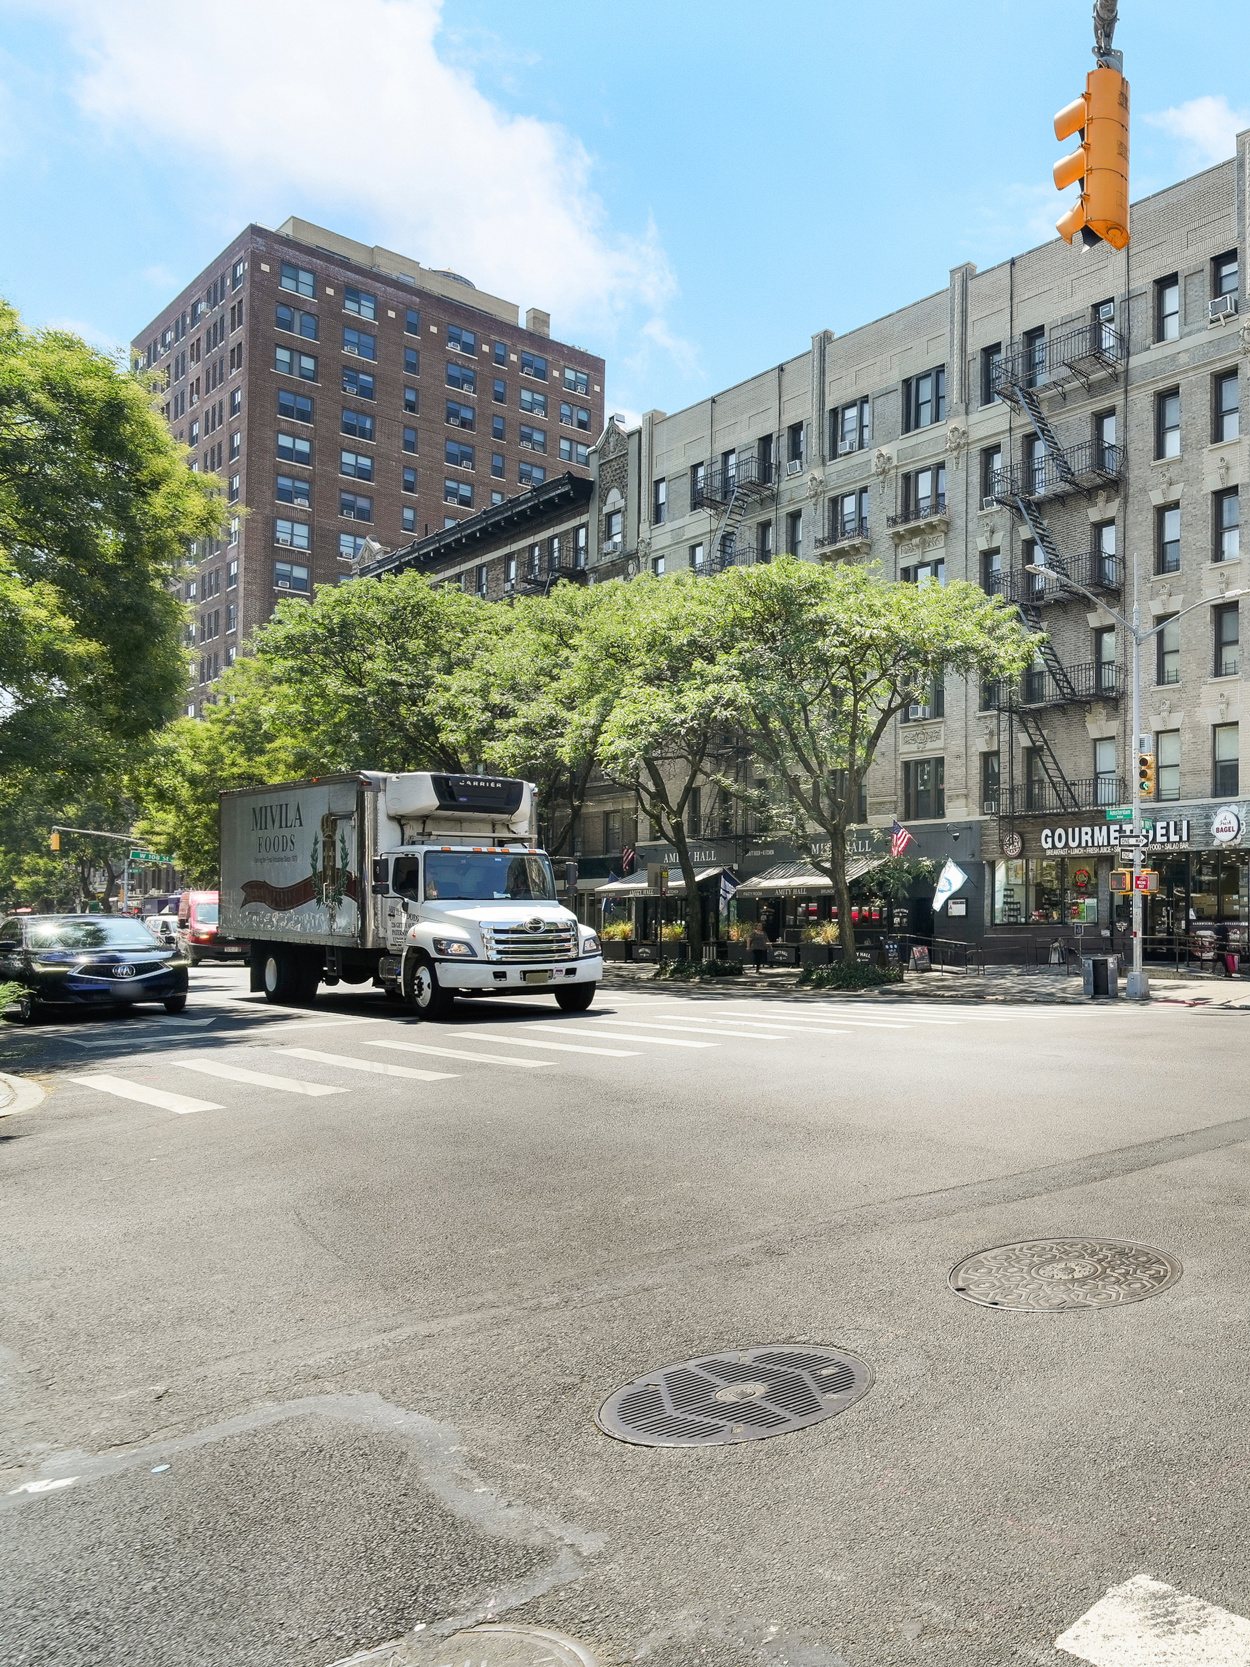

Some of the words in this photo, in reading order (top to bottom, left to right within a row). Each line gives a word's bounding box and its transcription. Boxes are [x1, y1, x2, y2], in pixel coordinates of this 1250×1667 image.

[251, 801, 304, 831] MIVILA
[1041, 823, 1134, 849] GOURMET
[1215, 826, 1236, 834] BAGEL
[258, 834, 296, 853] FOODS
[694, 850, 717, 862] HALL
